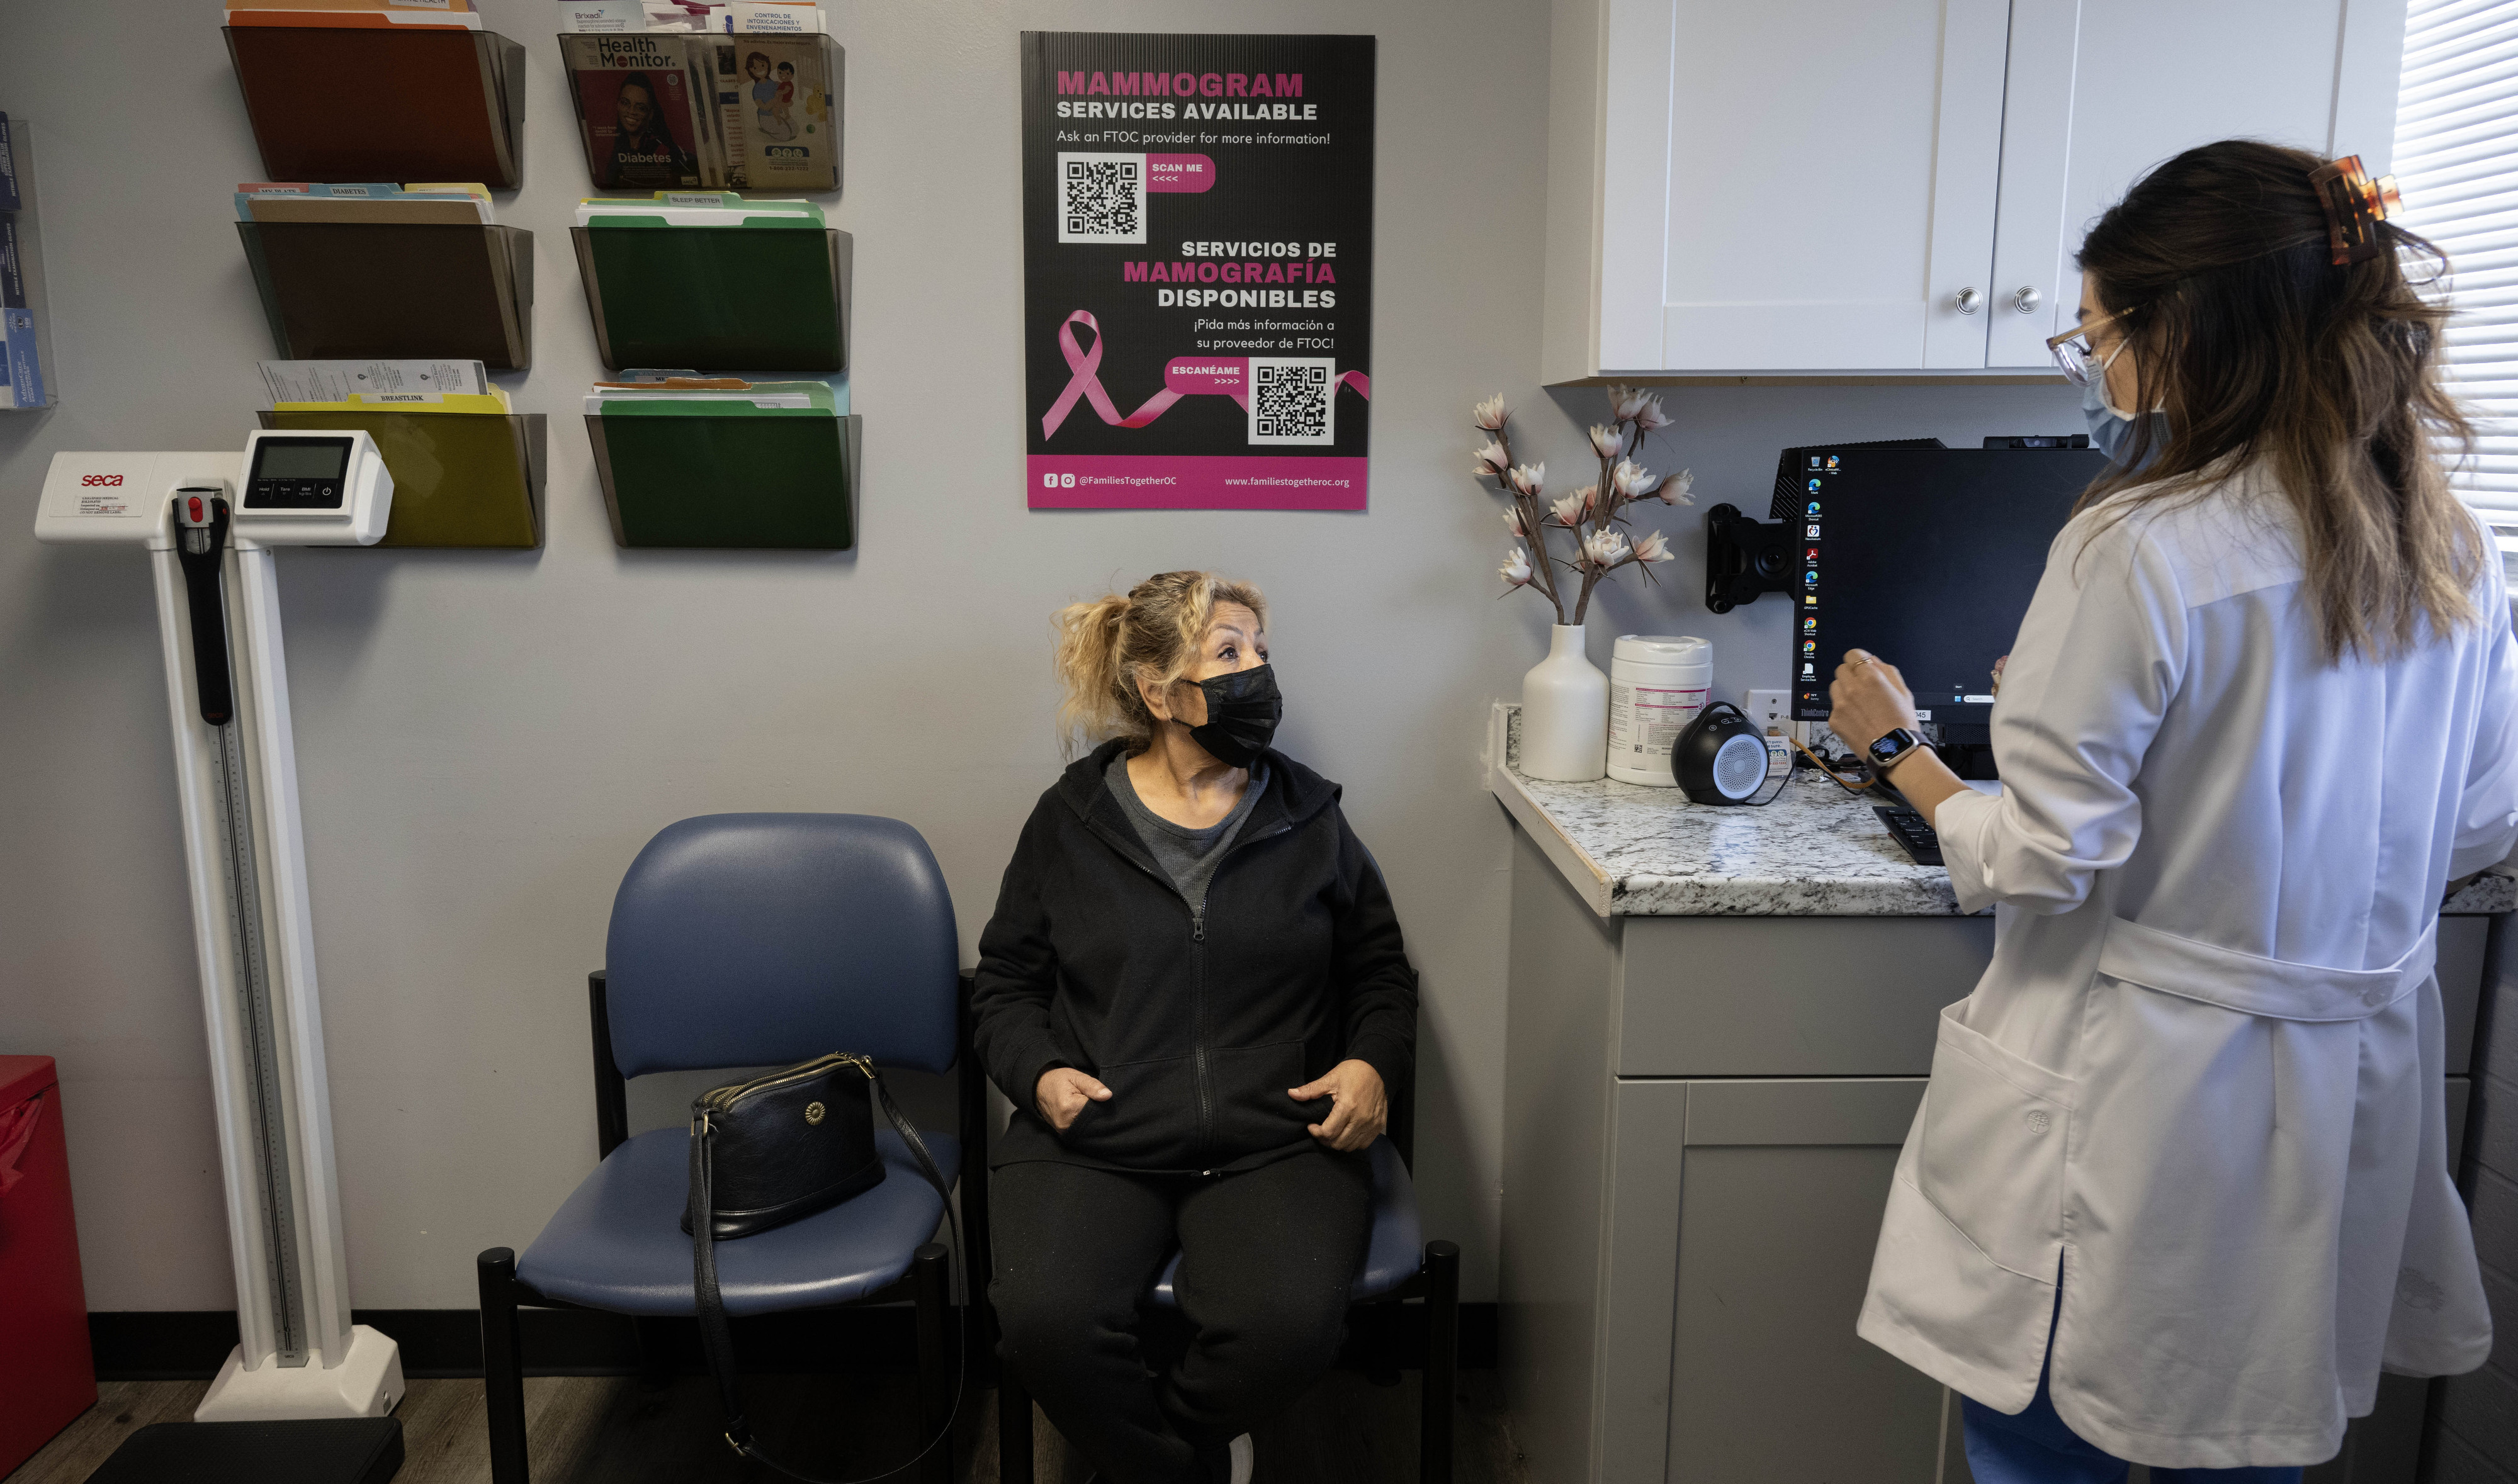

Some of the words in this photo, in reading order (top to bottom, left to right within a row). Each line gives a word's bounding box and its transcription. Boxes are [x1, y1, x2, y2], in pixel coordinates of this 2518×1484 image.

[598, 38, 656, 52] Health
[1058, 71, 1303, 98] MAMMOGRAM
[1057, 102, 1176, 119] SERVICES
[1183, 104, 1317, 120] AVAILABLE
[1057, 130, 1080, 142] Ask
[1084, 132, 1100, 142] an
[1104, 131, 1139, 143] FTOC
[1143, 131, 1195, 145] provider
[1200, 132, 1218, 143] for
[1222, 133, 1253, 144] more
[1256, 132, 1330, 145] information!
[4, 143, 12, 177] EXAMINATION
[618, 153, 672, 163] Diabetes
[1152, 163, 1183, 172] SCAN
[1186, 164, 1202, 172] ME
[695, 196, 720, 205] BETTER
[1182, 242, 1300, 257] SERVICIOS
[1308, 242, 1336, 257] DE
[1124, 259, 1336, 284] MAMOGRAFÍA
[1159, 289, 1336, 308] DISPONIBLES
[1194, 319, 1224, 332] ¡Pida
[1228, 318, 1251, 330] más
[1254, 319, 1323, 330] información
[1327, 321, 1335, 330] a
[1197, 339, 1210, 348] su
[1214, 337, 1273, 350] proveedor
[1279, 337, 1293, 349] de
[1297, 338, 1333, 349] FTOC!
[1172, 365, 1240, 375] ESCANÉAME
[18, 361, 27, 403] AdvanCare
[81, 475, 123, 486] seca
[1080, 475, 1176, 486] @FamiliesTogetherOC
[1225, 477, 1350, 488] www.familiestogetheroc.org
[1801, 709, 1829, 717] ThinkCentre
